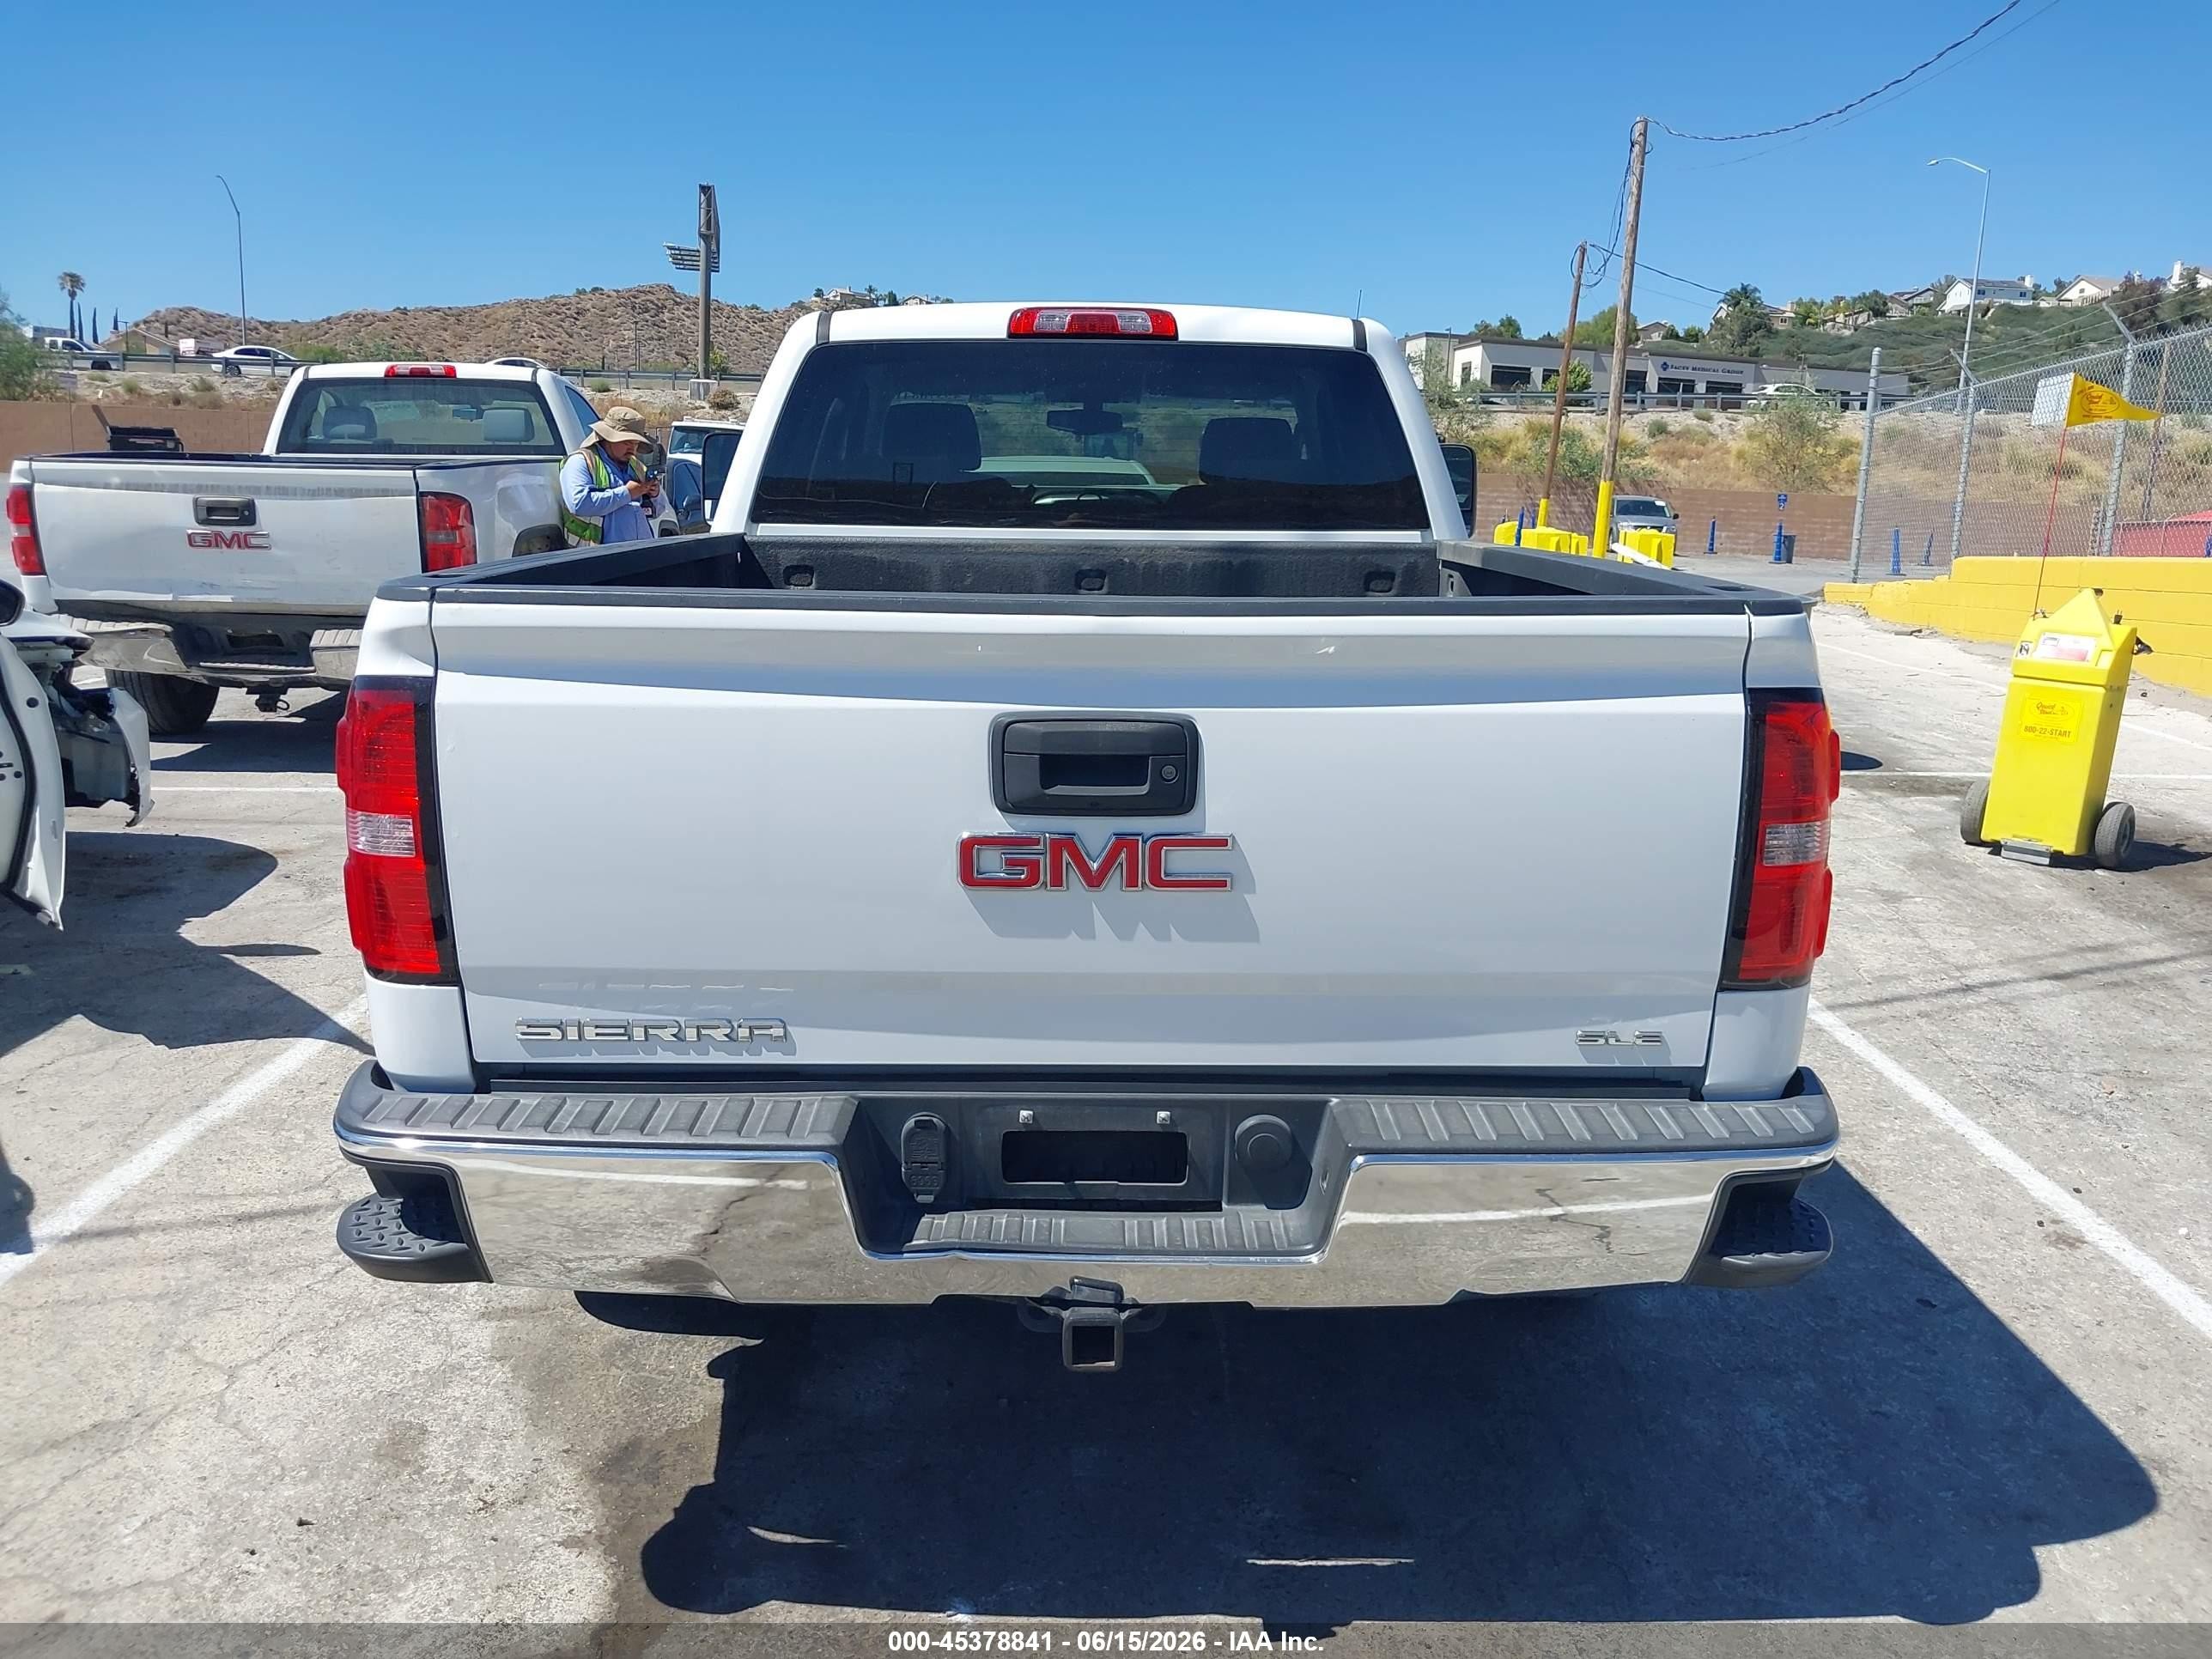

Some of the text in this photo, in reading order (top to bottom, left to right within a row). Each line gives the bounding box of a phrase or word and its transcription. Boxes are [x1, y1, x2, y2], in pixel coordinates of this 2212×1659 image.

[185, 529, 272, 550] GMC
[2024, 726, 2071, 738] 800-22-START
[956, 831, 1233, 891] GMC
[515, 1017, 788, 1042] SIERRA
[1575, 1030, 1662, 1046] SLE
